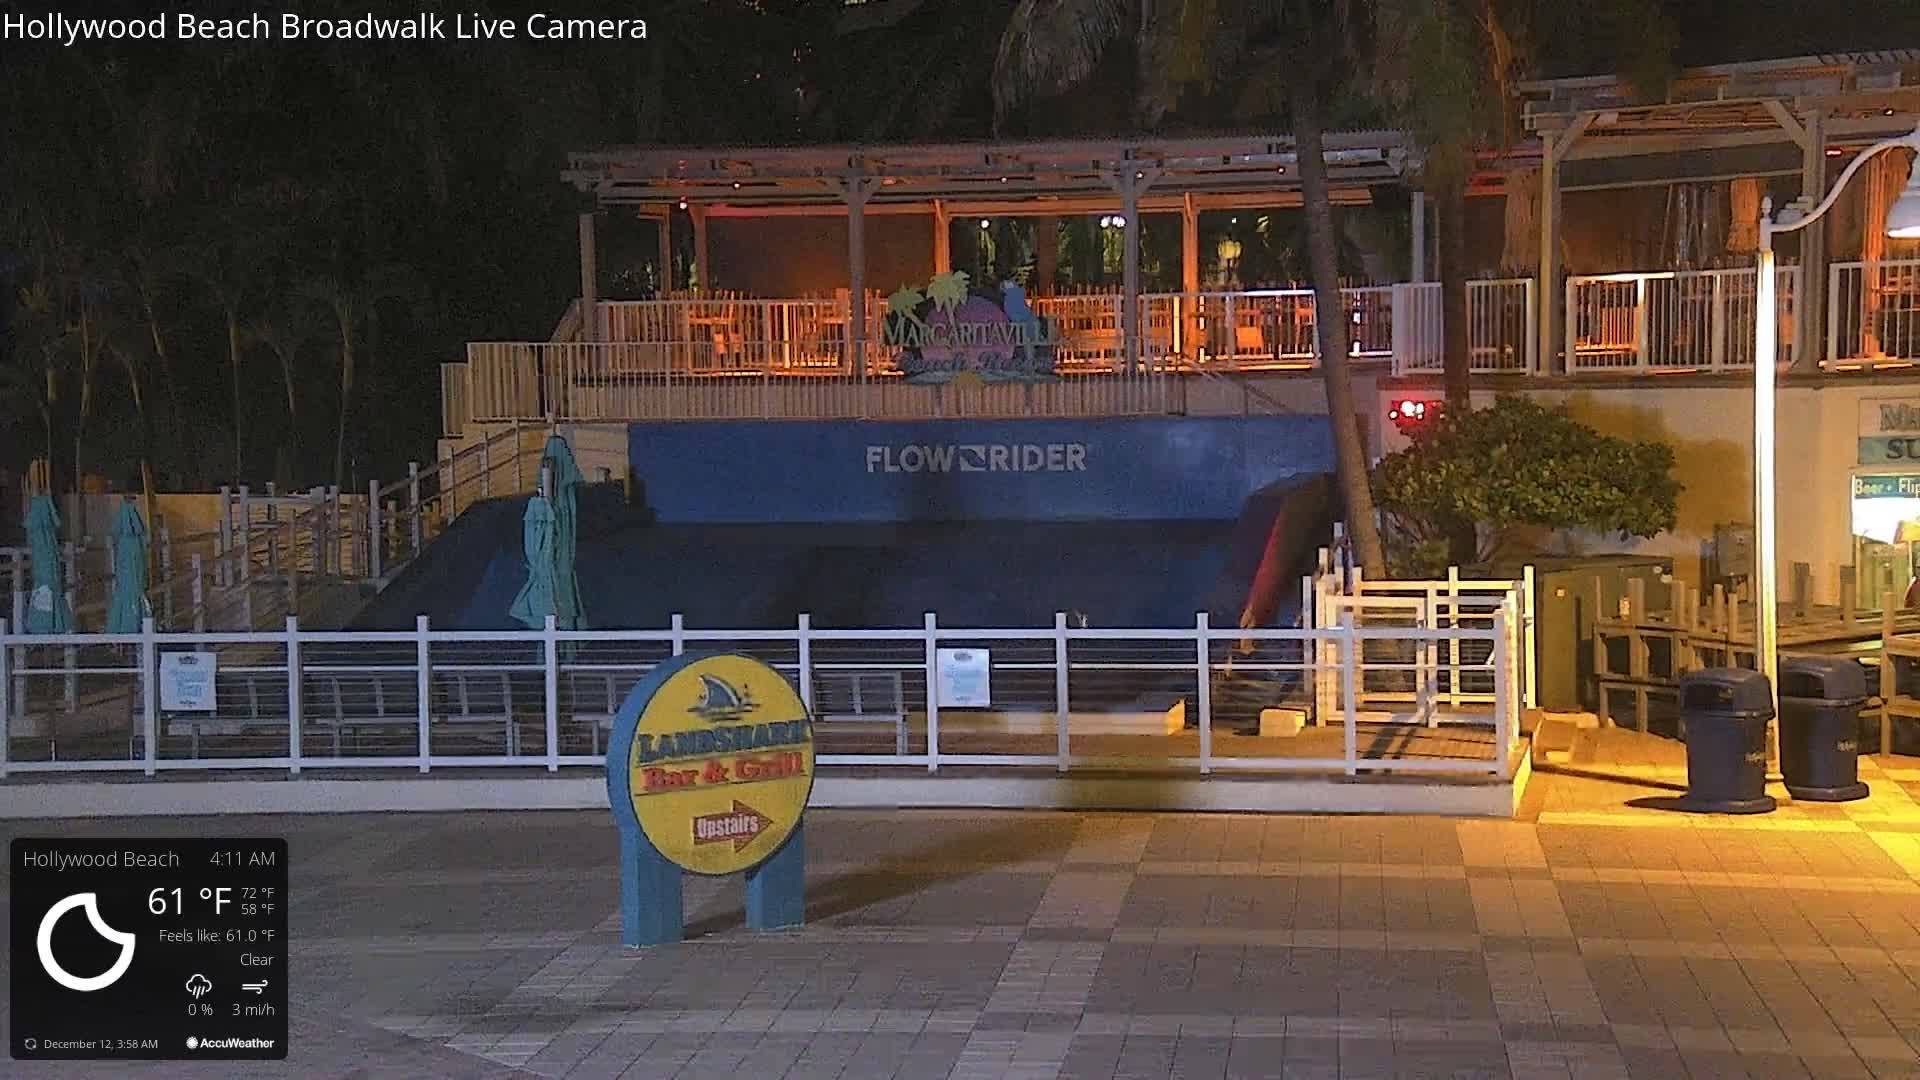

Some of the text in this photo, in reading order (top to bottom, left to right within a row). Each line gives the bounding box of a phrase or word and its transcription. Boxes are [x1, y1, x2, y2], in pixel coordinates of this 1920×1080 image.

[866, 443, 1088, 473] FLOW RIDER
[641, 751, 804, 792] Bar & Grill
[697, 813, 760, 839] Upstairs
